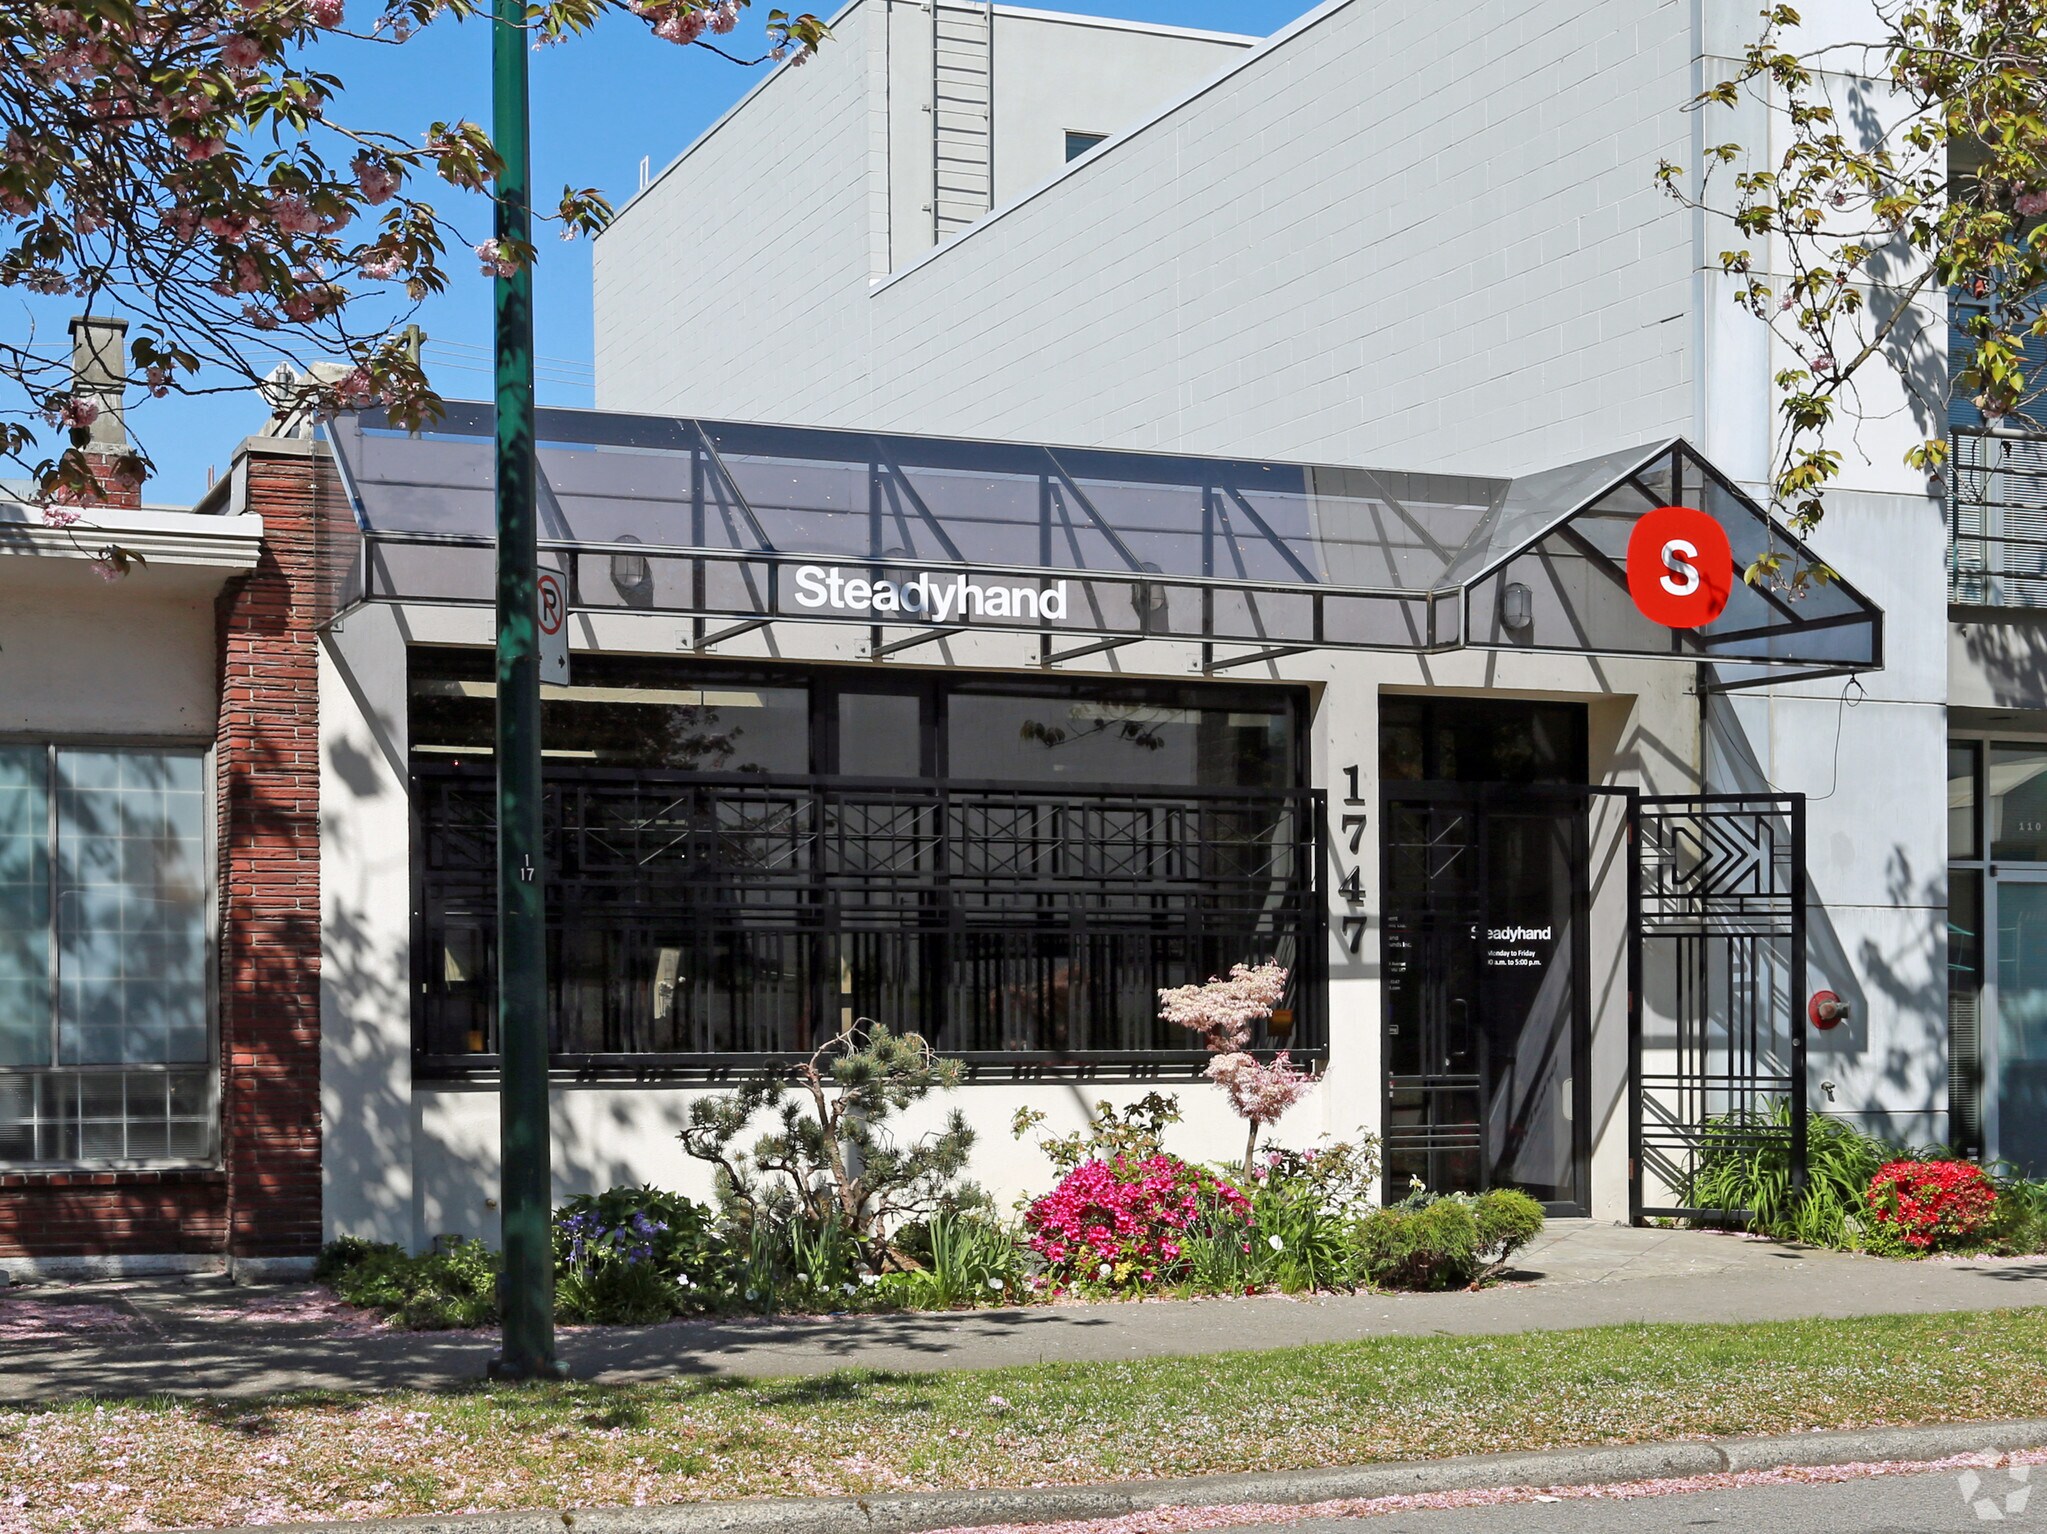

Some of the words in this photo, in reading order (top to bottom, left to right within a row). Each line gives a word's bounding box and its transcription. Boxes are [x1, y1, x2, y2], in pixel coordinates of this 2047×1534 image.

[1660, 539, 1700, 596] S
[795, 565, 1067, 623] Steadyhand
[2018, 822, 2042, 831] 110
[1338, 764, 1367, 954] 1747
[521, 867, 535, 881] 17
[1471, 926, 1551, 942] Seadyhand
[1518, 949, 1535, 957] Friday
